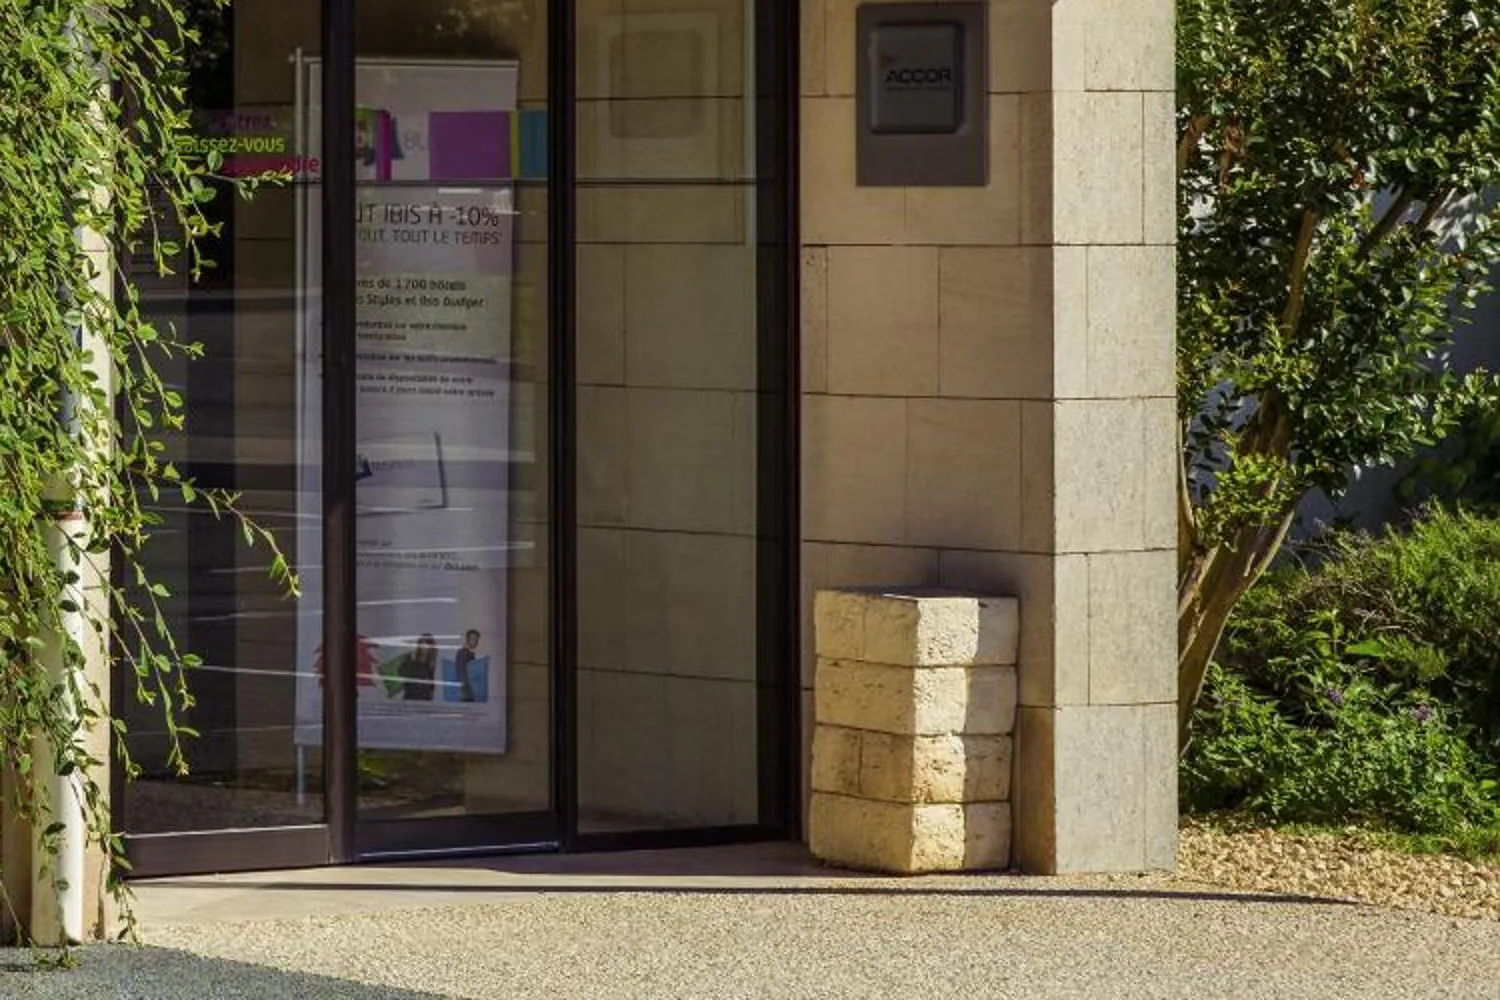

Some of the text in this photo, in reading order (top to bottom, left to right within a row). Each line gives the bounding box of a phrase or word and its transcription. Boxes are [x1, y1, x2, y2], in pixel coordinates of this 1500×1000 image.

[884, 68, 952, 84] ACCOR
[384, 203, 422, 226] IBIS
[428, 201, 443, 225] À
[449, 205, 501, 227] -10%
[392, 228, 429, 243] TOUT
[432, 230, 450, 244] LE
[453, 231, 501, 246] TEMPS
